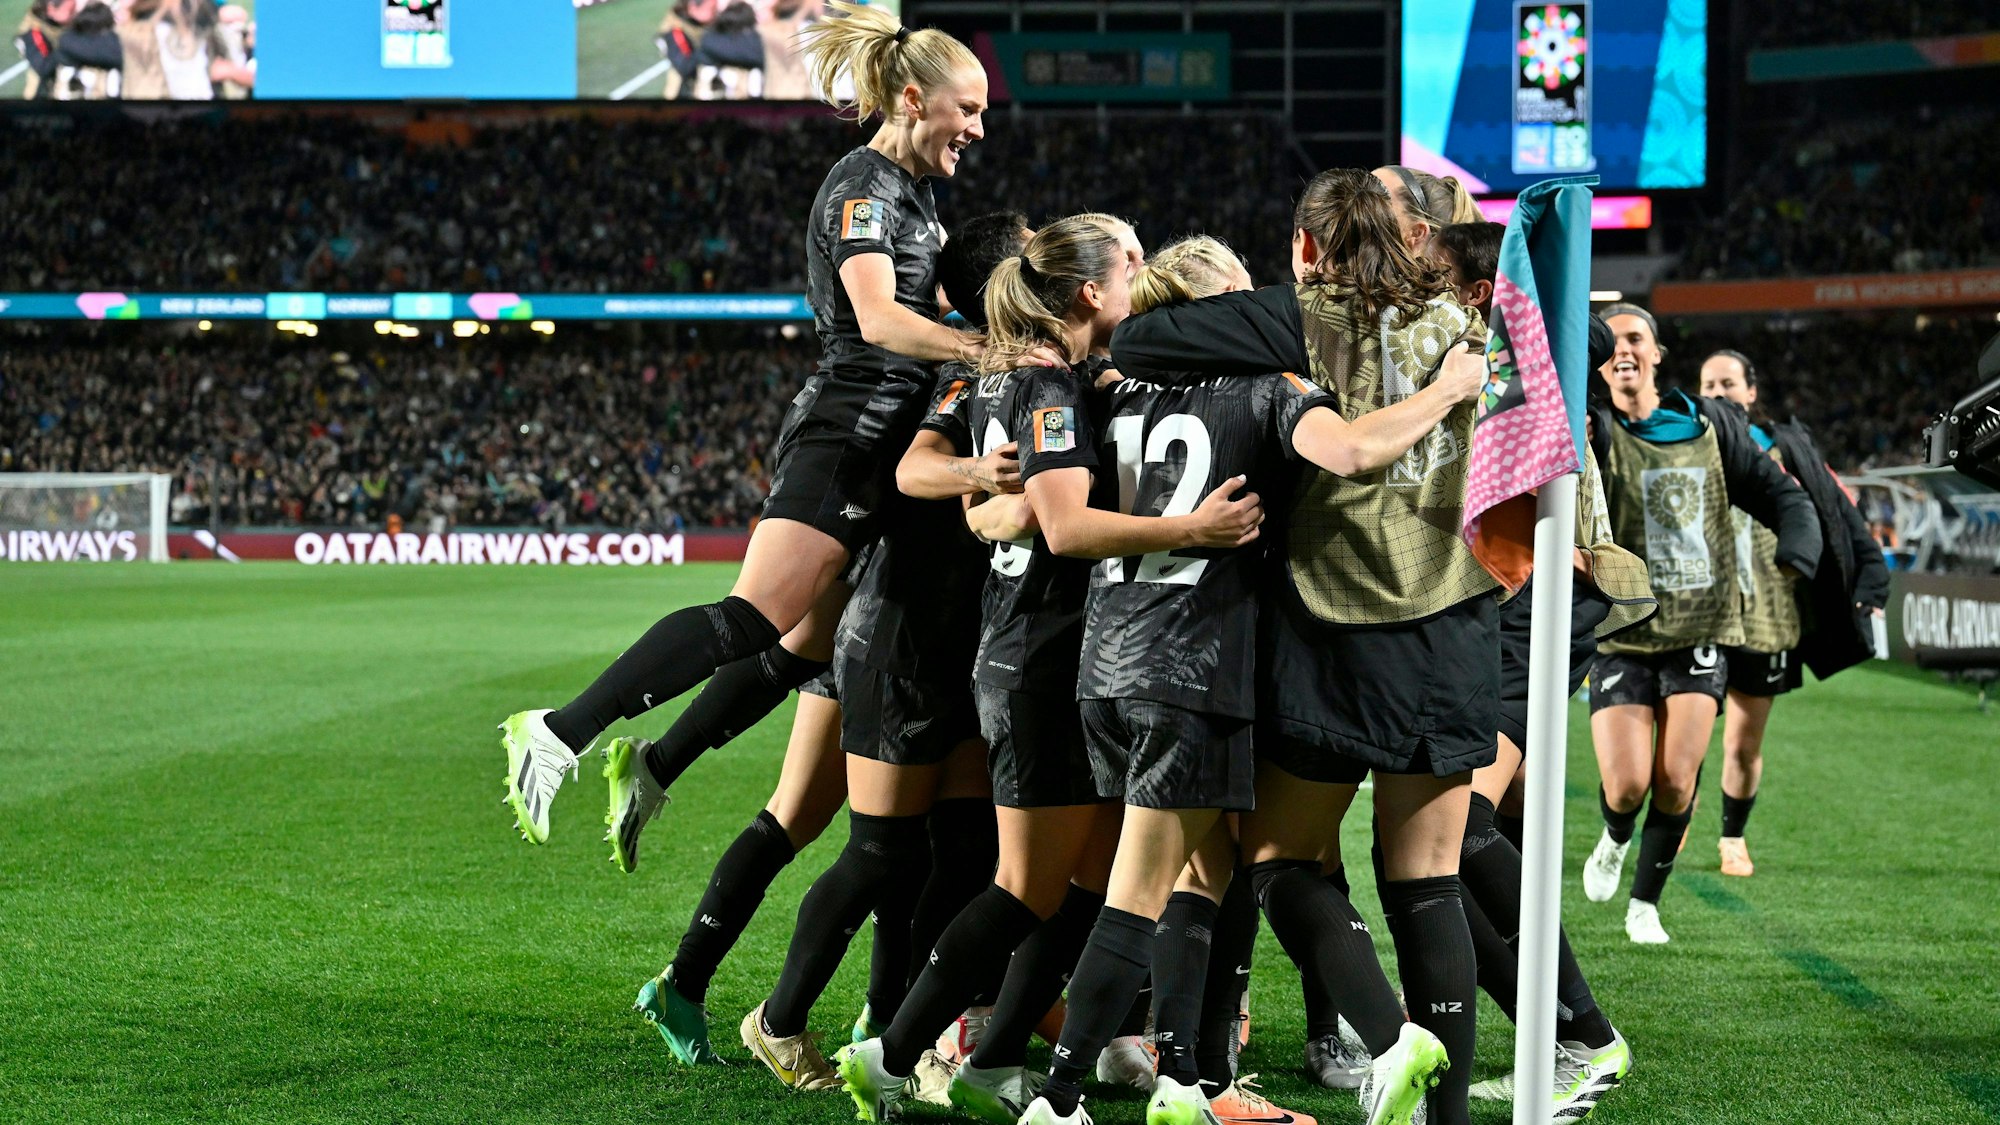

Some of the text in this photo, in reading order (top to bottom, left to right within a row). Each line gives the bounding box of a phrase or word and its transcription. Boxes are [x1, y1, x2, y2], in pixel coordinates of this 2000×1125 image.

[1104, 413, 1212, 585] 12
[0, 530, 137, 562] IRWAYS
[1903, 592, 1949, 649] QATAR
[700, 913, 721, 930] NZ
[1430, 1001, 1463, 1014] NZ
[1155, 1031, 1174, 1042] NZ
[1054, 1042, 1072, 1060] NZ
